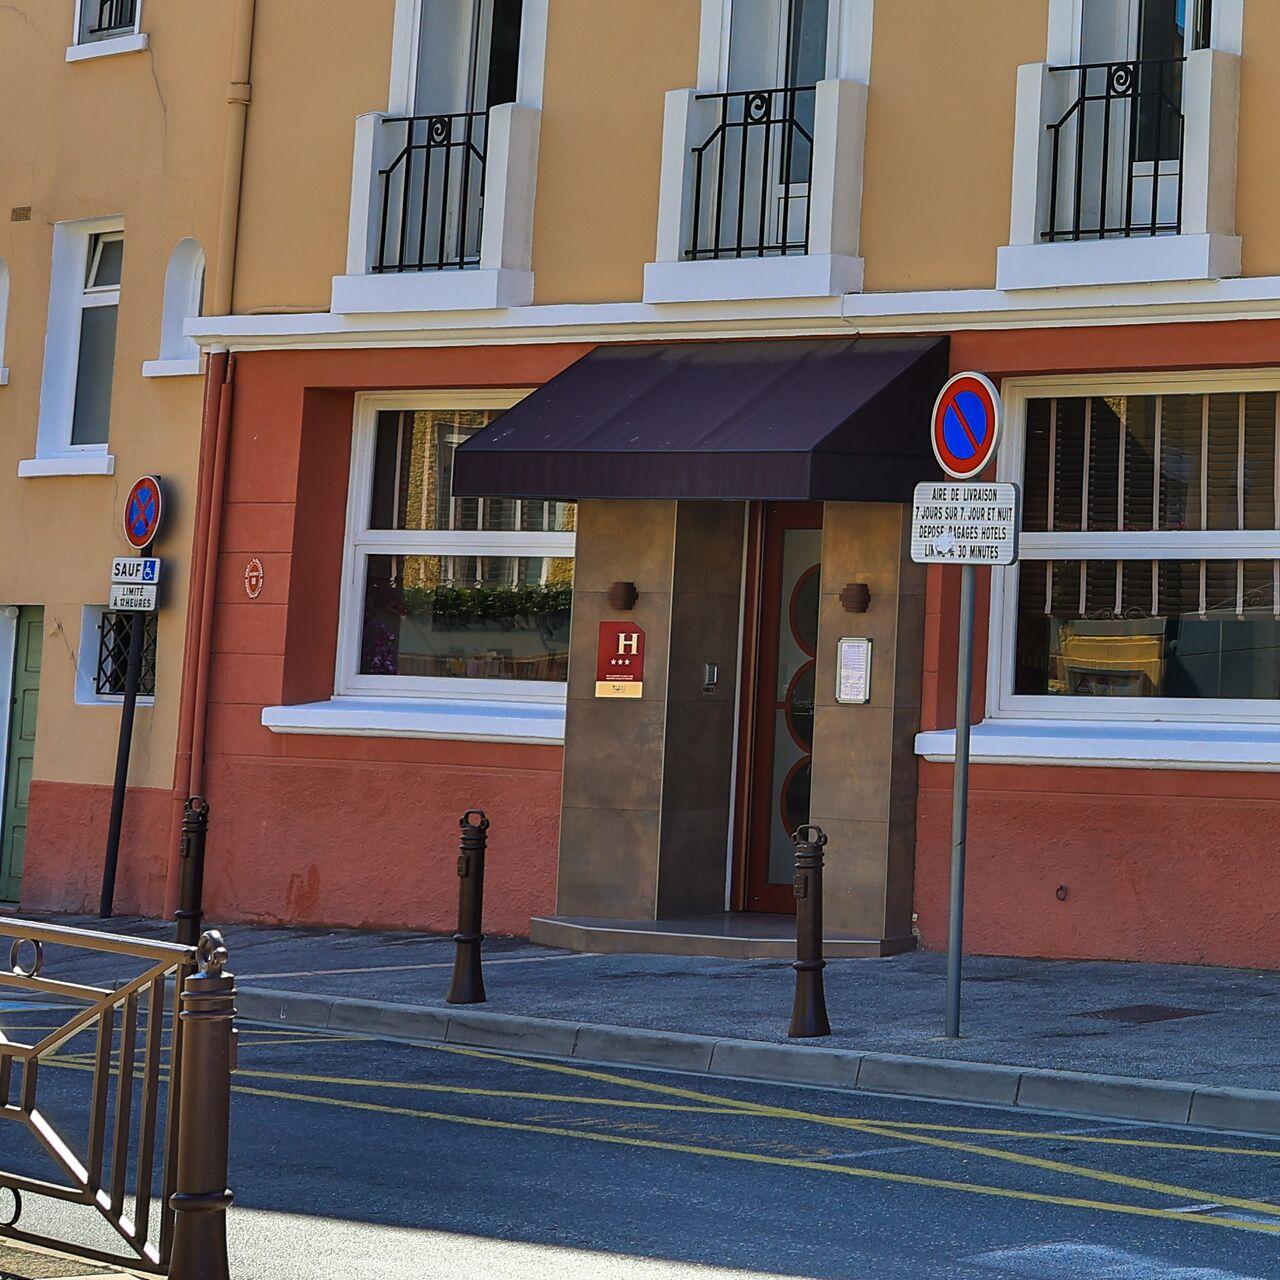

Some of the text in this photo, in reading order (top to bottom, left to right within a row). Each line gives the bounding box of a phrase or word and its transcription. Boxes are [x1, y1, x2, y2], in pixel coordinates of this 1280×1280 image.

[932, 487, 998, 502] AIRE DE LIVRAISON
[915, 506, 920, 520] 7
[921, 506, 943, 520] JOURS
[945, 507, 958, 520] SUR
[967, 507, 985, 520] JOUR
[987, 507, 996, 521] ET
[997, 507, 1013, 521] NUIT
[981, 526, 1007, 540] HOTELS
[958, 544, 967, 558] 30
[969, 545, 999, 559] MINUTES
[114, 562, 142, 577] SAUF
[122, 585, 145, 597] LIMITÉ
[616, 632, 641, 655] H
